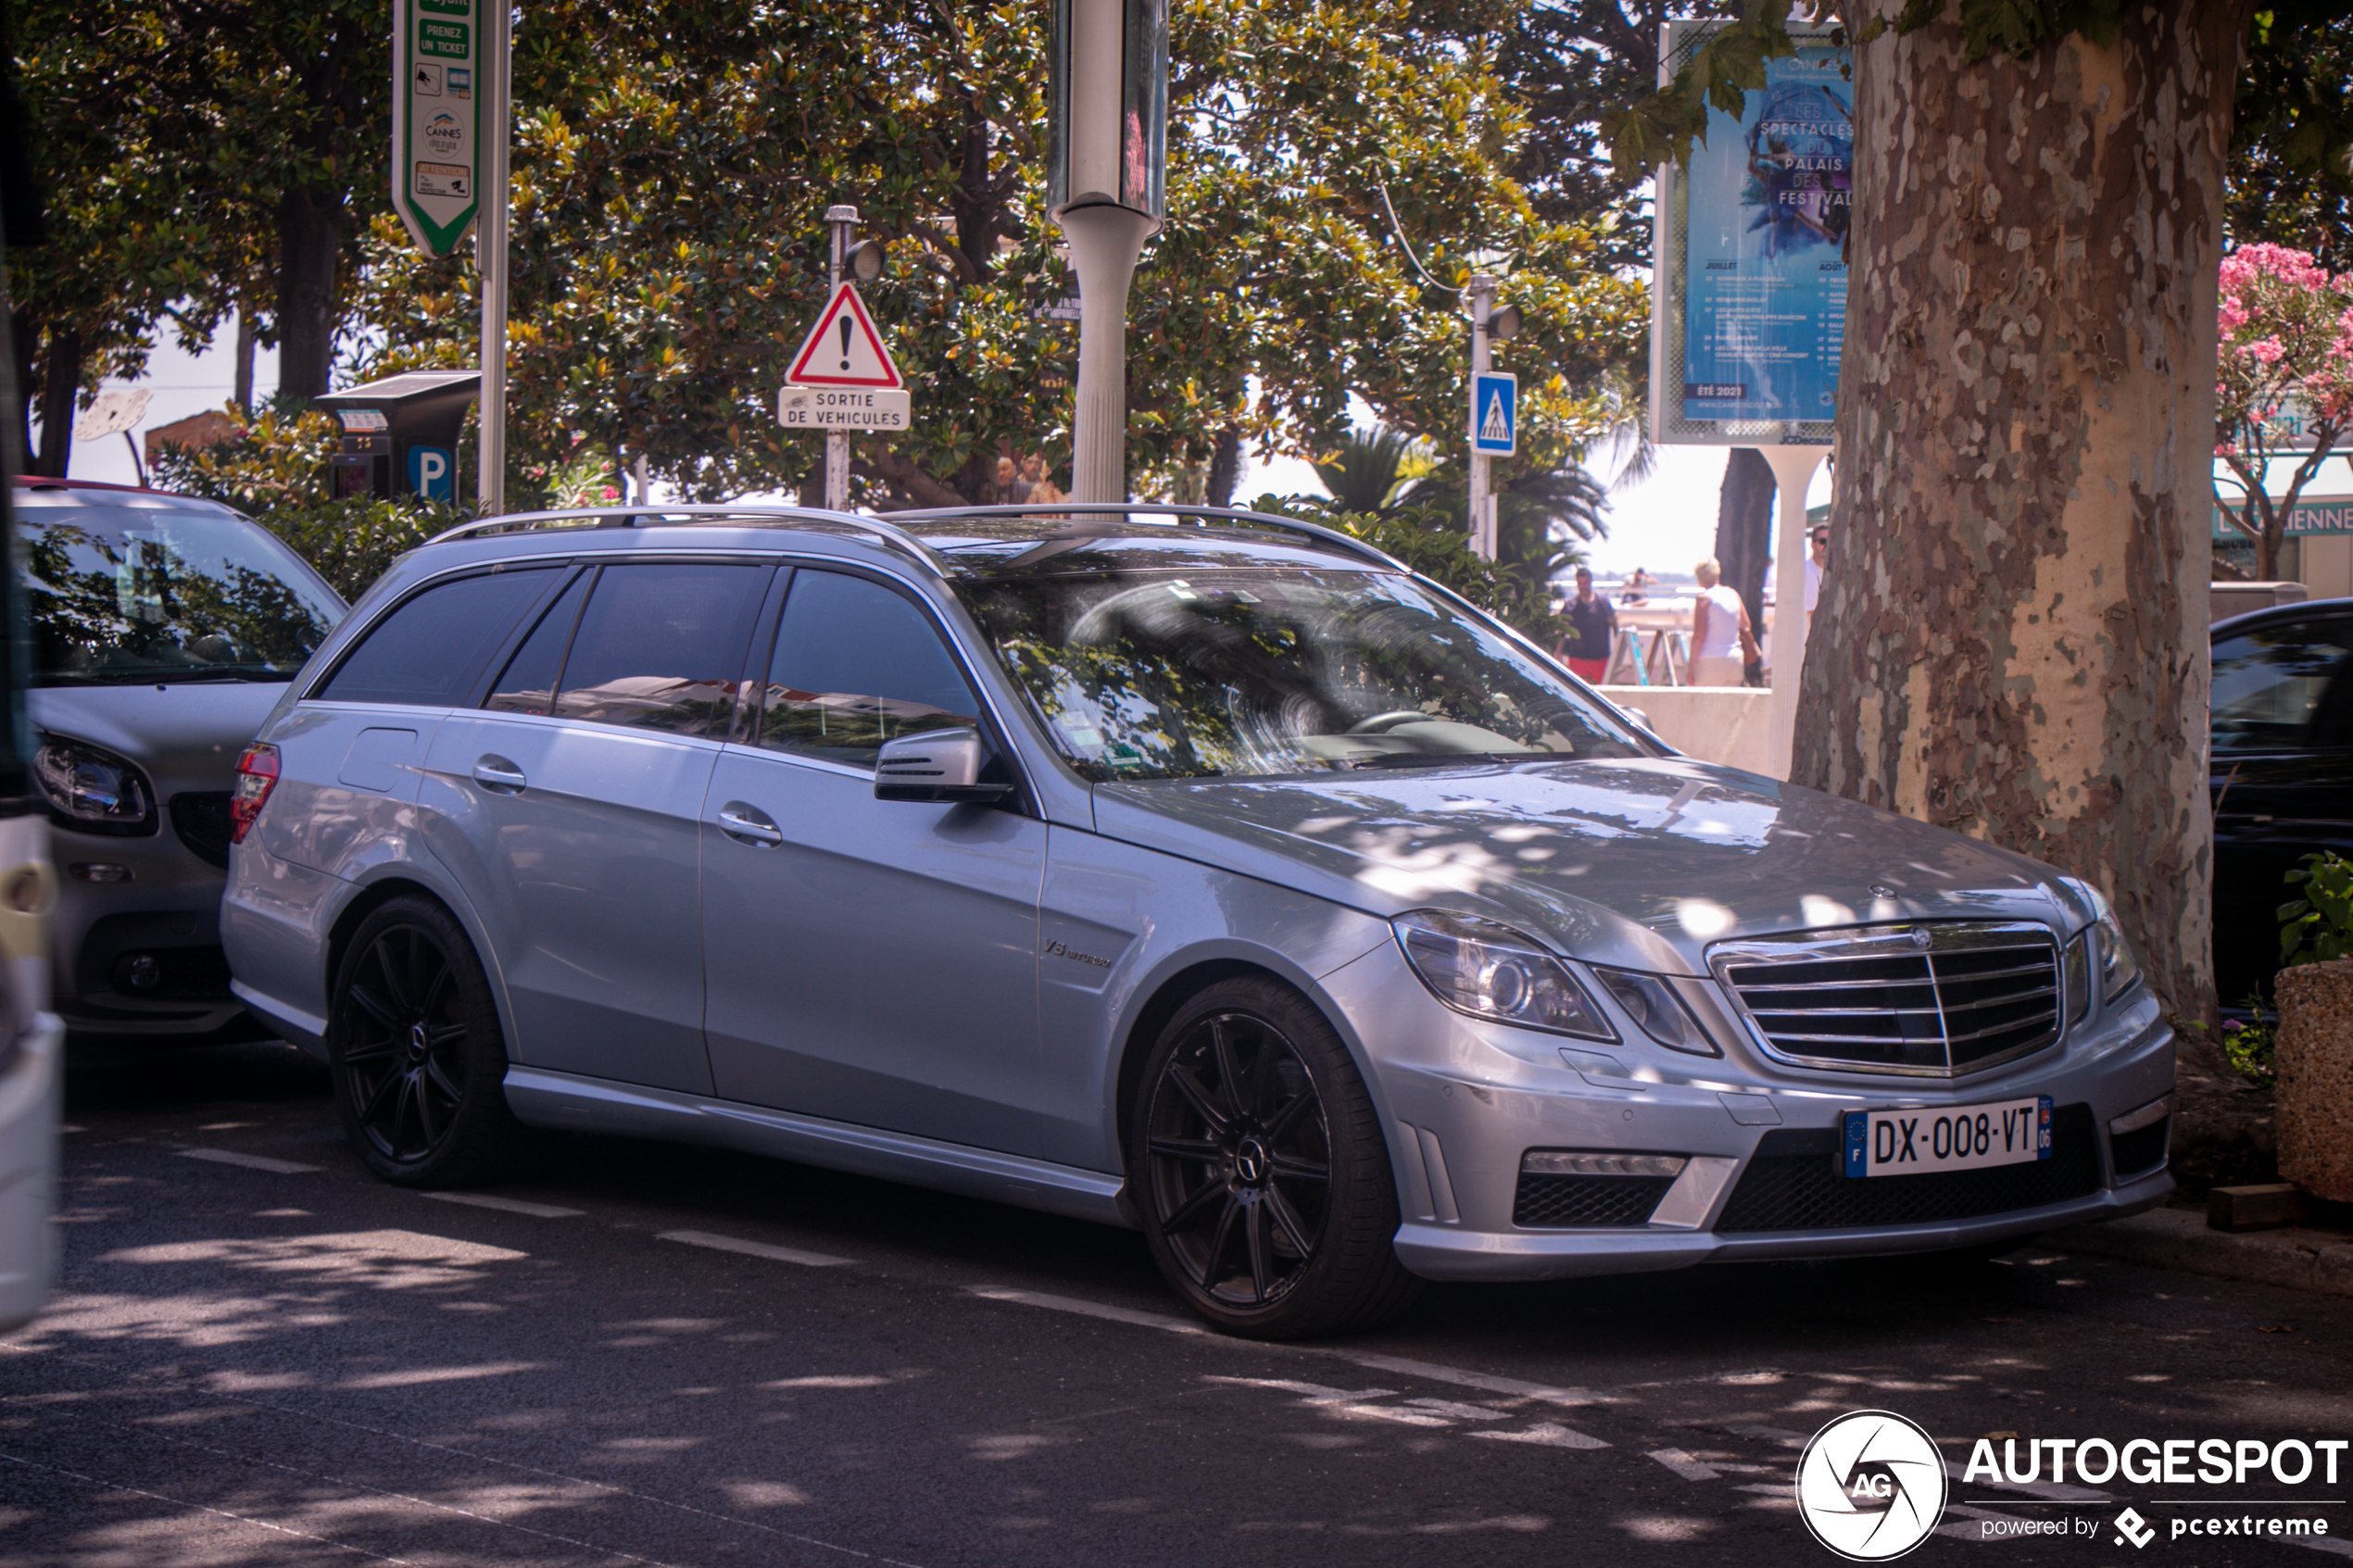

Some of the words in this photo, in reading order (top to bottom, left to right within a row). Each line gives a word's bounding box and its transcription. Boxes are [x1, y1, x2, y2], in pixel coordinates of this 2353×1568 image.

[427, 24, 462, 39] PRENEZ
[422, 40, 434, 51] UN
[437, 41, 466, 55] TICKET
[1795, 106, 1821, 119] LES
[426, 125, 461, 139] CANNES
[1760, 122, 1854, 136] SPECTACLES
[1807, 140, 1827, 153] DU
[419, 164, 467, 176] ATTENTION
[1784, 157, 1843, 170] PALAIS
[1793, 175, 1820, 188] DES
[1705, 262, 1737, 270] JUILLET
[1818, 261, 1843, 271] AOÛT
[1697, 384, 1714, 396] ÉTÉ
[1716, 386, 1742, 396] 2021
[816, 393, 874, 407] SORTIE
[788, 410, 807, 423] DE
[816, 411, 900, 426] VEHICULES
[1780, 435, 1833, 445] JCDecaux
[421, 452, 446, 496] P
[1044, 937, 1066, 957] V8
[1066, 950, 1111, 968] BITURBO
[1875, 1107, 2033, 1164] DX-008-VT
[2039, 1128, 2051, 1149] 06
[1853, 1148, 1861, 1162] F
